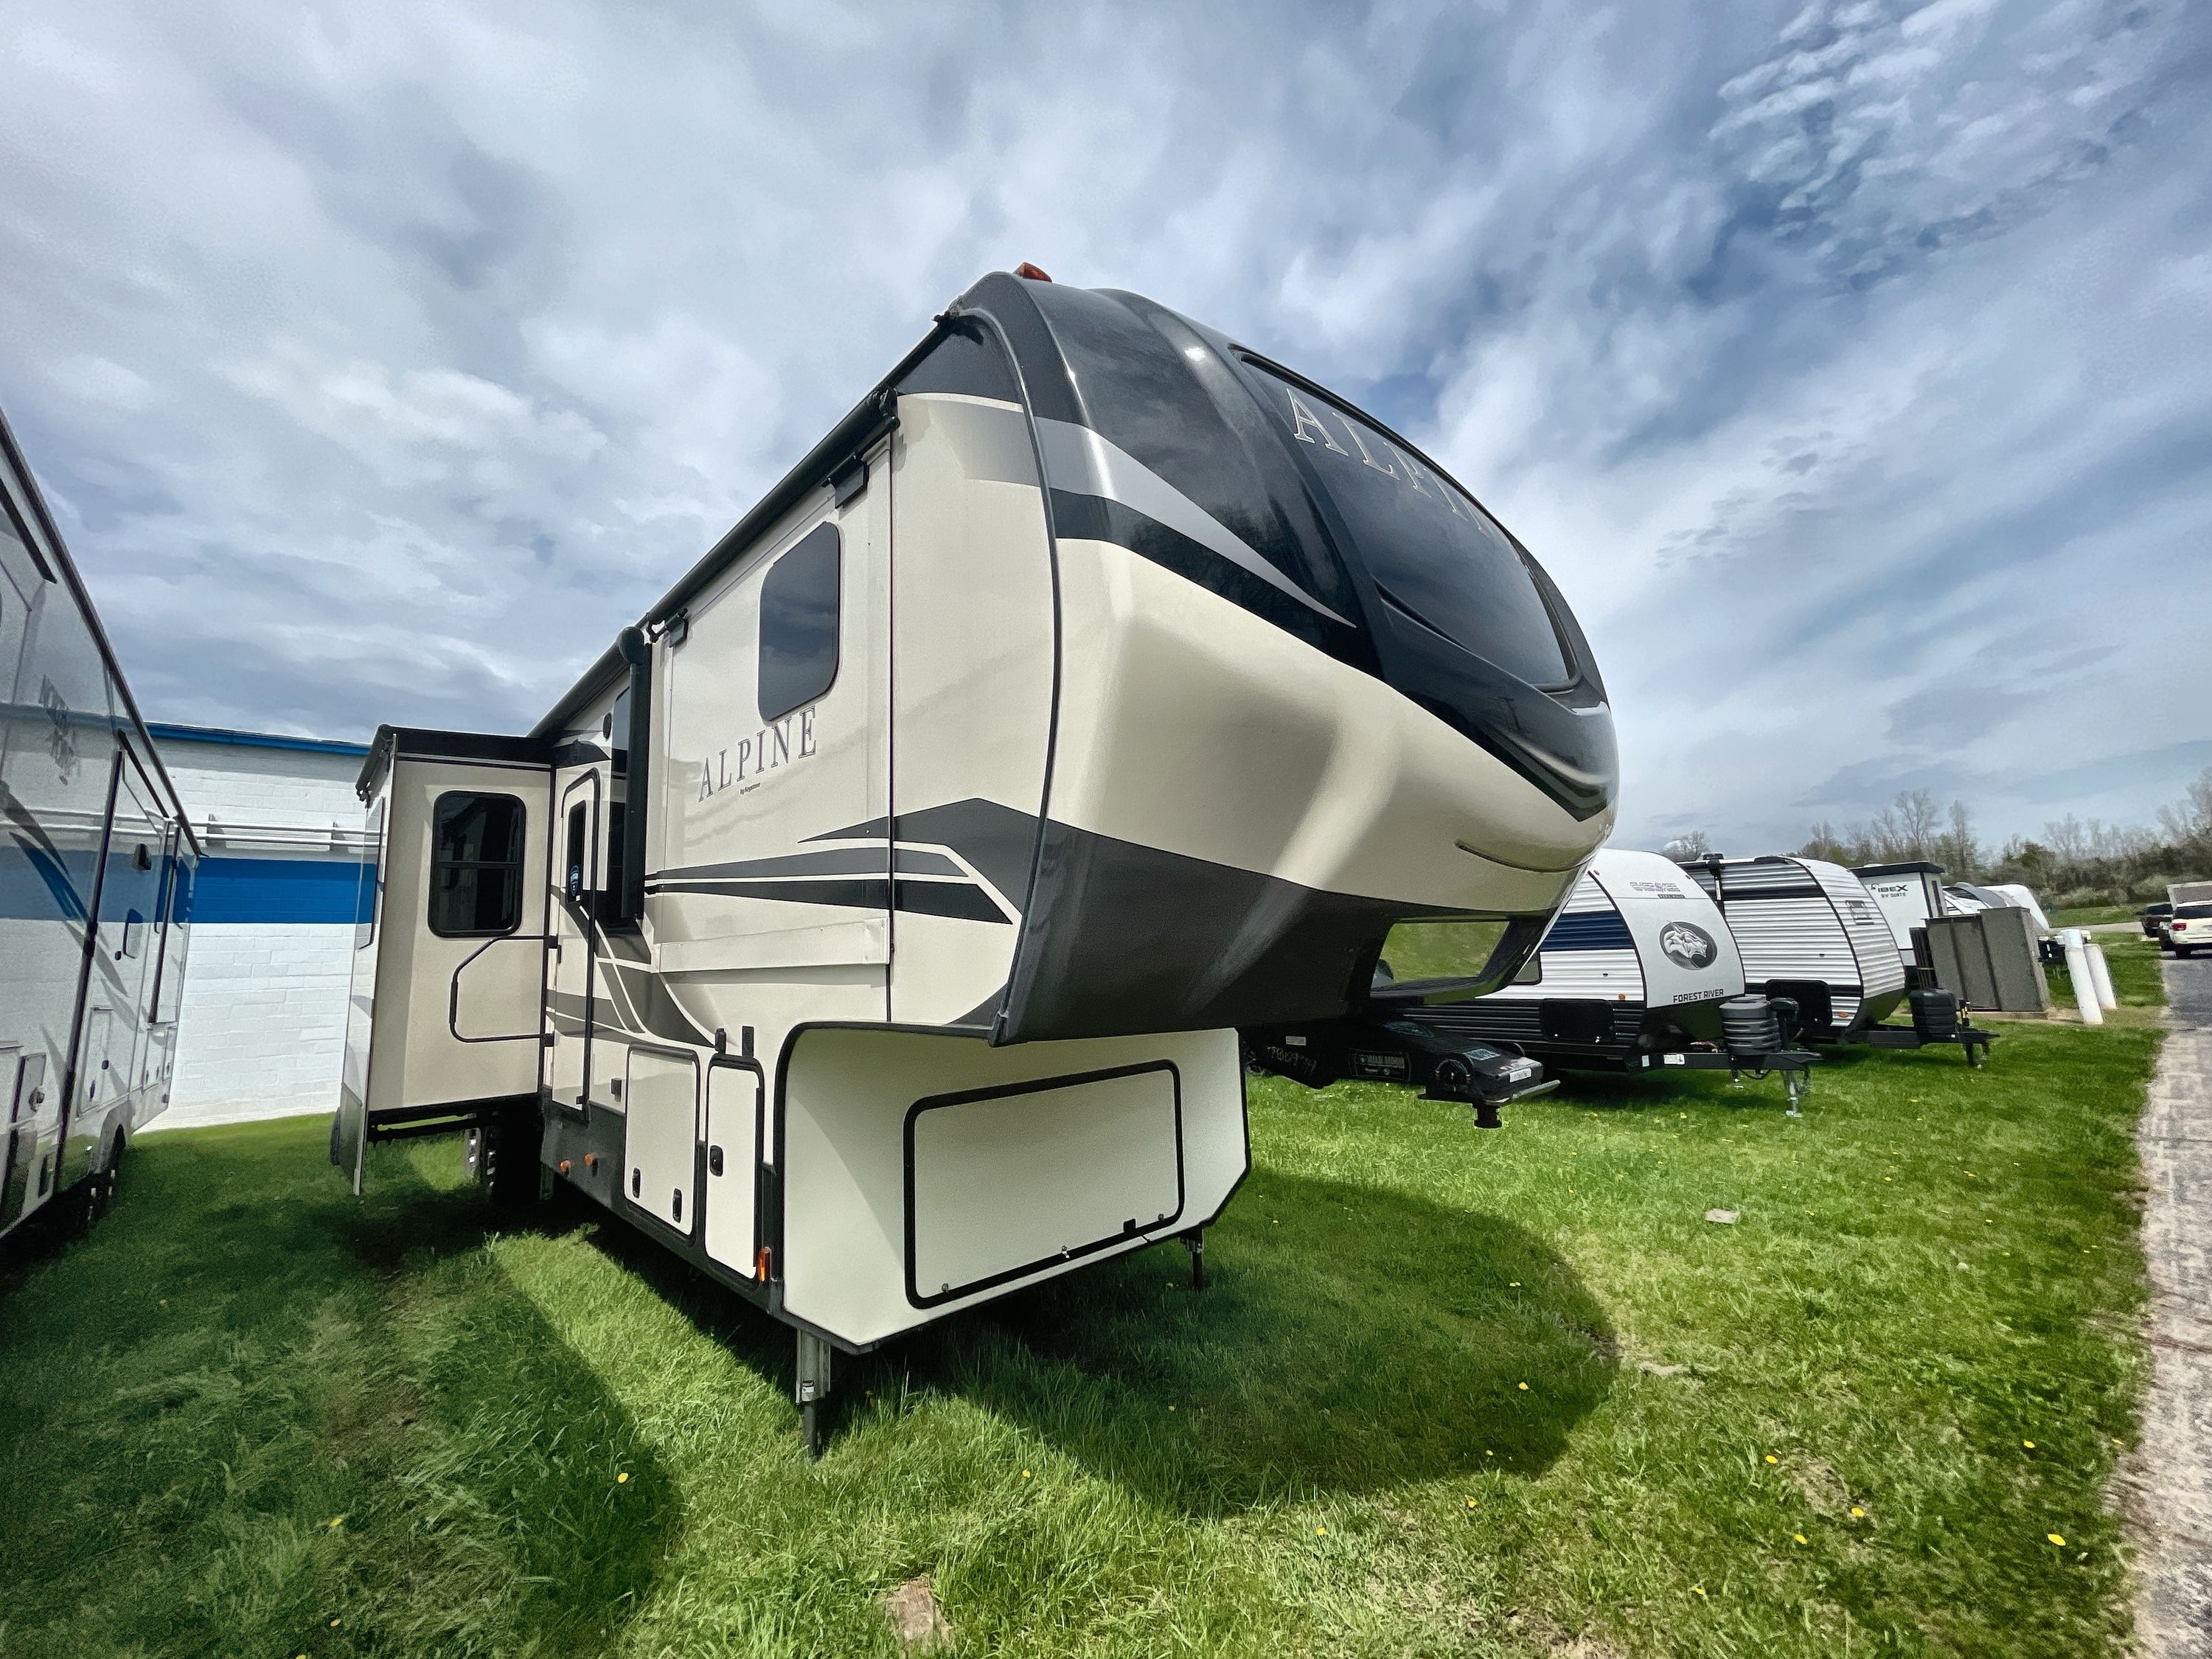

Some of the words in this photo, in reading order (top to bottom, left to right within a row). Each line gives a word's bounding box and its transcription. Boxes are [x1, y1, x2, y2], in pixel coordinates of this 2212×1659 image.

[1286, 387, 1519, 561] ALPIN
[698, 705, 816, 802] ALPINE
[1878, 884, 1908, 892] IBEX
[1673, 991, 1702, 1003] FOREST
[1703, 988, 1724, 998] RIVER
